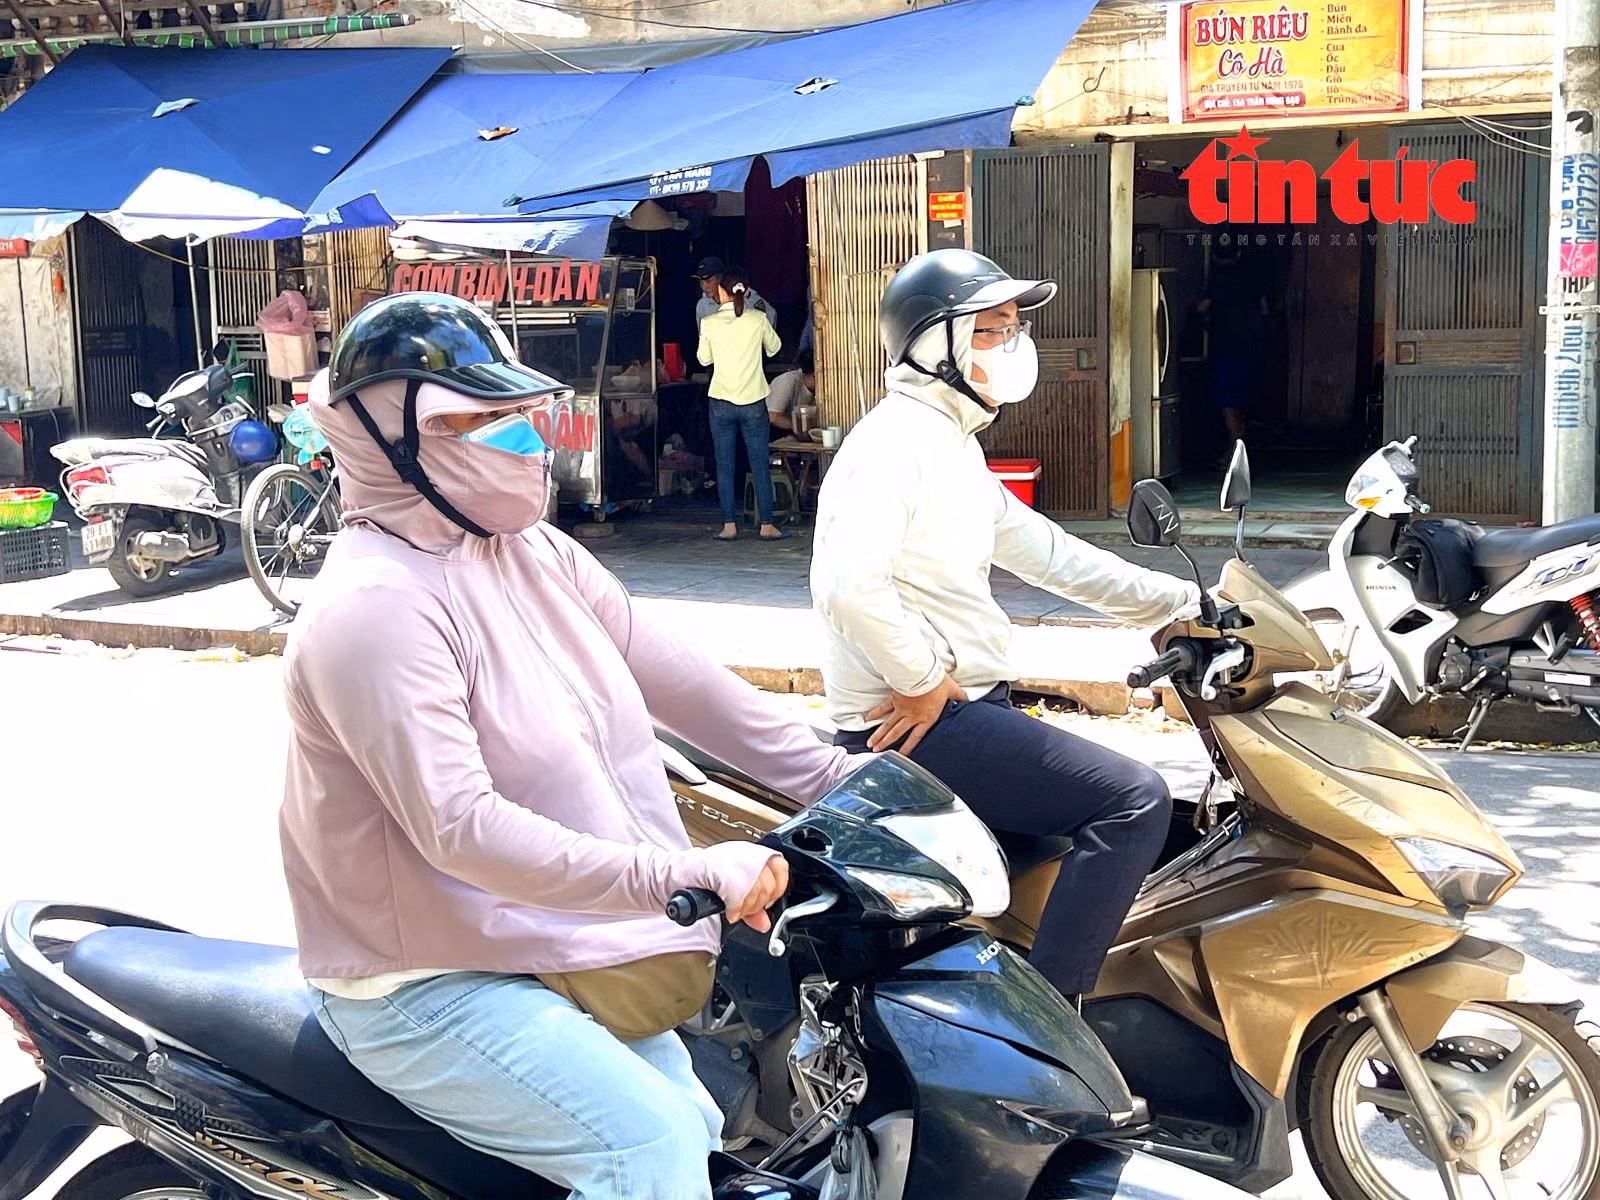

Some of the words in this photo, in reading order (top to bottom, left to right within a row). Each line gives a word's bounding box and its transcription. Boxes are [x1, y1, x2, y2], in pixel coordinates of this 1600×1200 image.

[1327, 3, 1347, 13] Bún
[1197, 9, 1245, 44] BÚN
[1252, 5, 1308, 40] RIÊU
[1327, 25, 1352, 35] Bánh
[1355, 24, 1368, 33] đa
[1326, 43, 1345, 52] Cua
[1218, 49, 1244, 77] Cô
[1248, 47, 1283, 76] Hà
[1326, 64, 1346, 75] Đậu
[532, 402, 595, 452] DÂN
